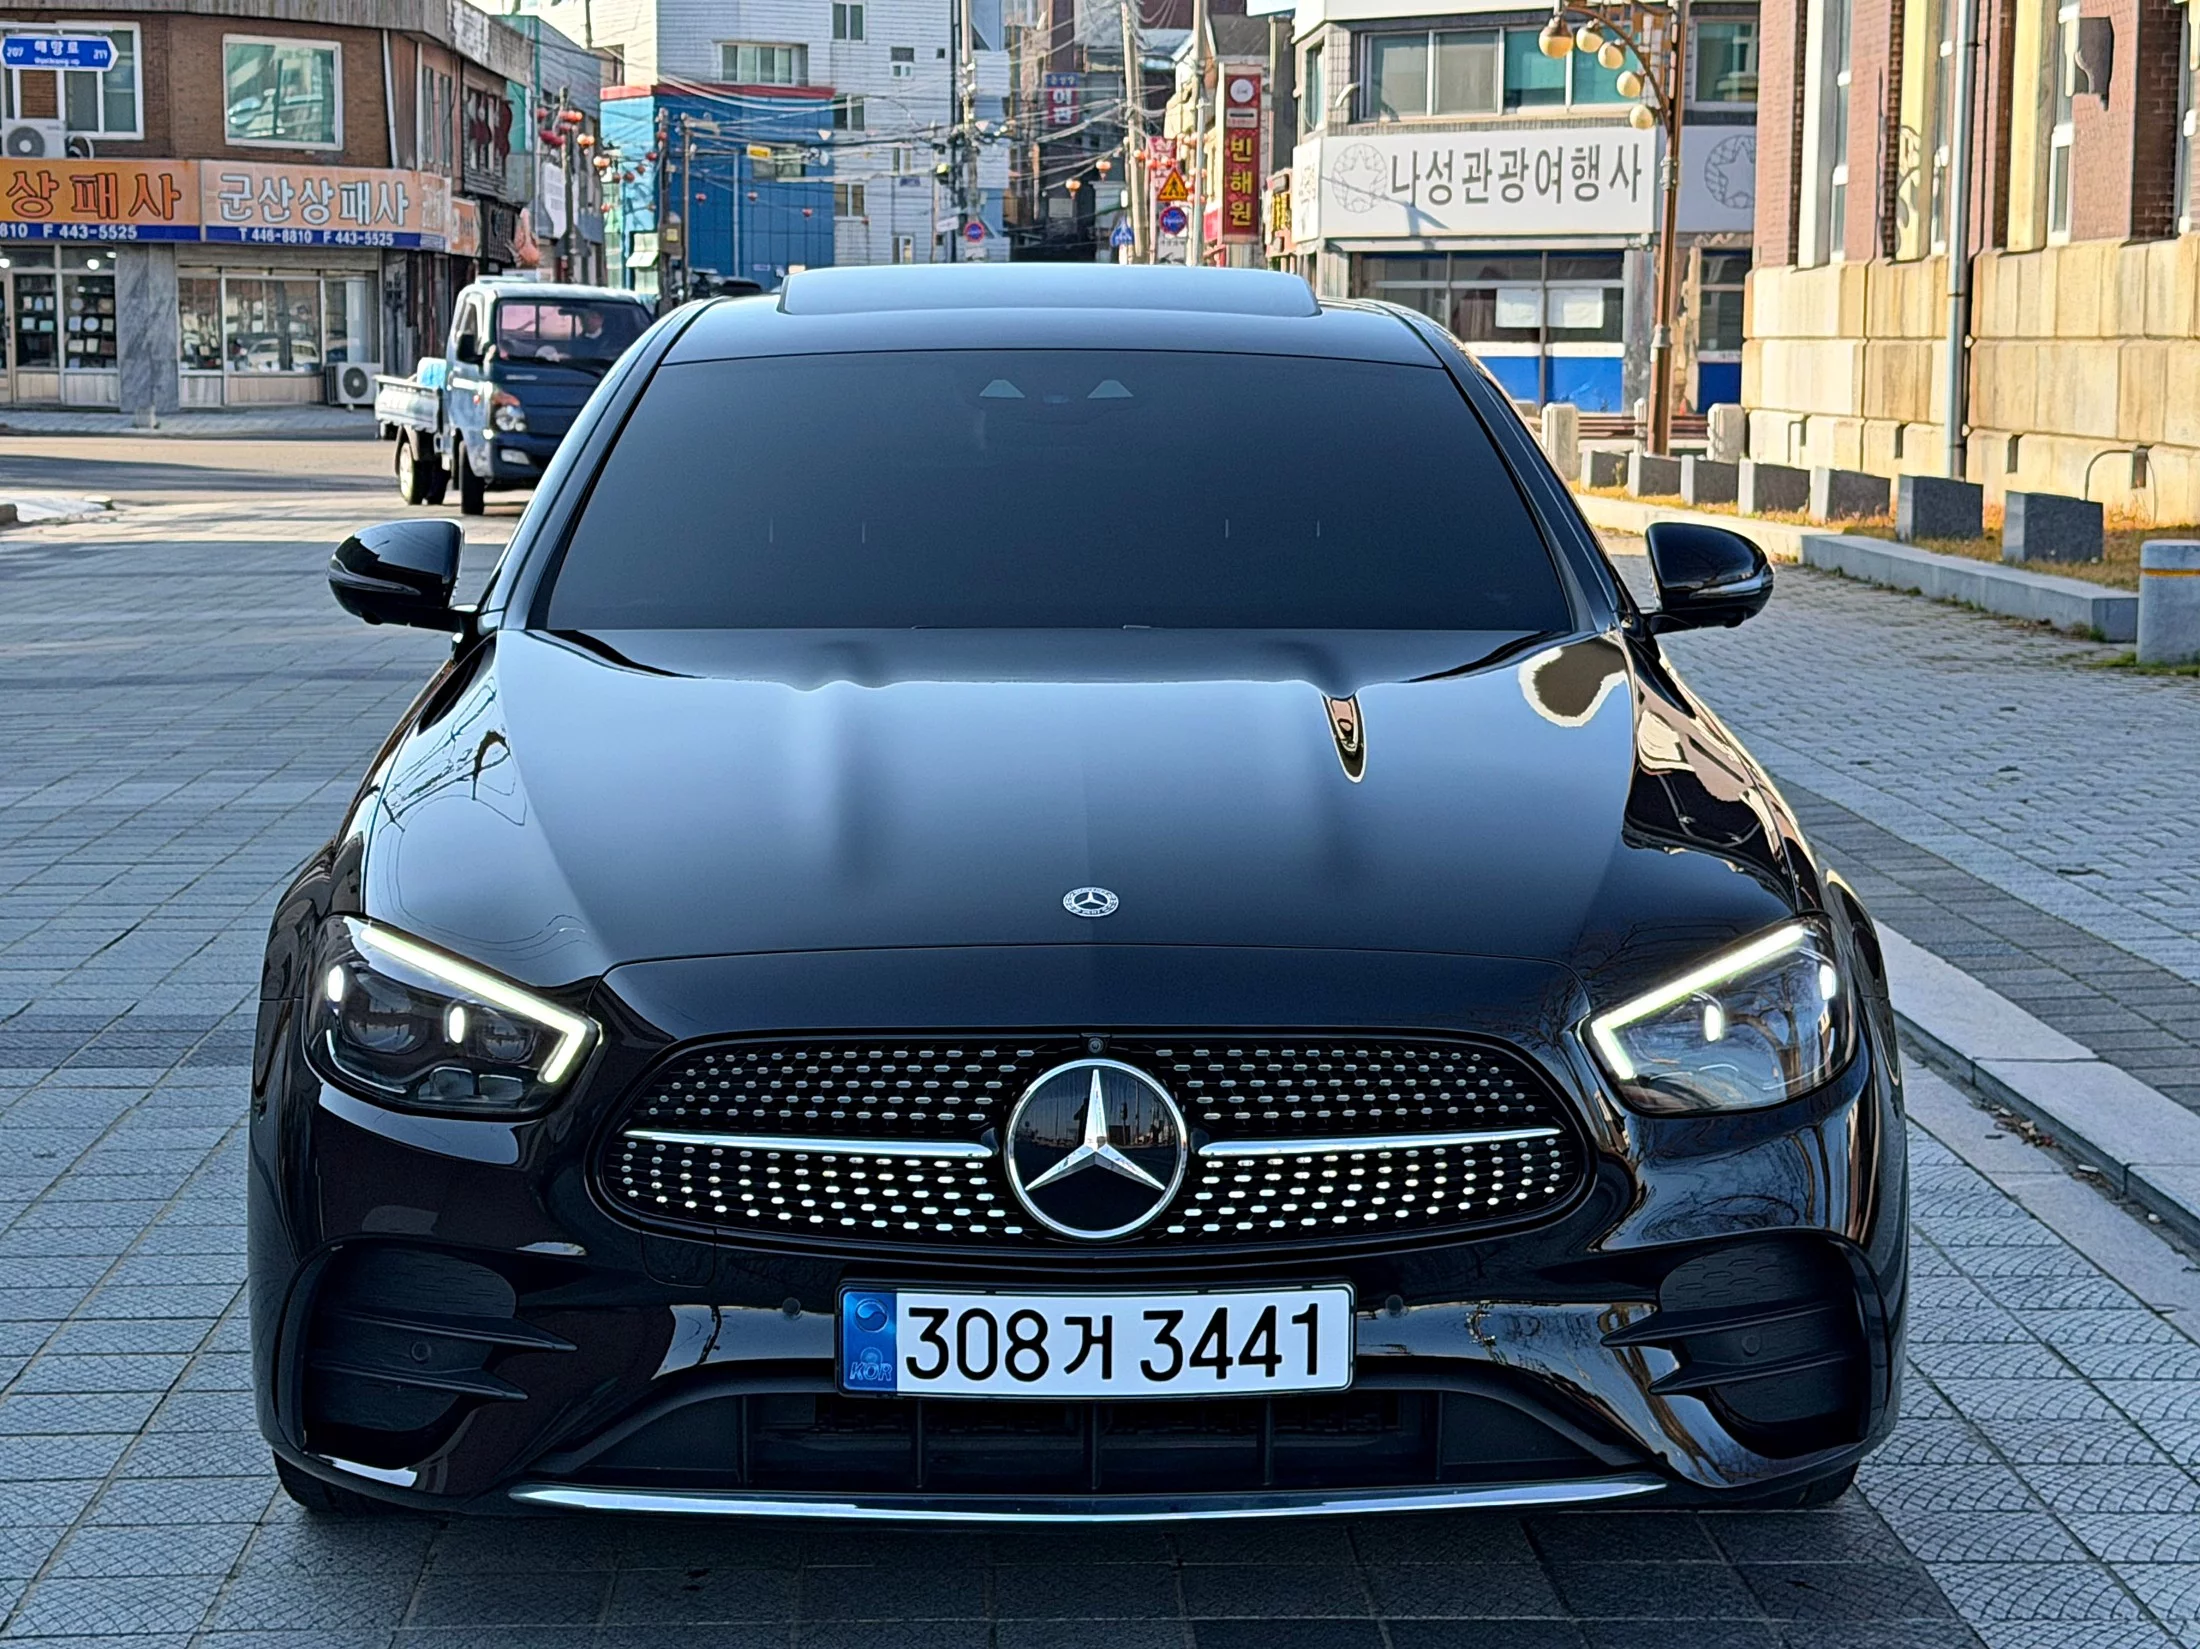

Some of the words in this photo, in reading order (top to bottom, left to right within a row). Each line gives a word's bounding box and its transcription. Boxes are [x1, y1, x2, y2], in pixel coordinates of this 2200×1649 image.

[6, 170, 182, 221] 상패사
[218, 172, 410, 226] 군산상패사
[1230, 137, 1253, 226] 빈해원
[1391, 143, 1642, 207] 나성관광여행사
[43, 224, 53, 237] F
[59, 225, 138, 240] 443-5525
[238, 227, 247, 241] T
[323, 231, 333, 244] F
[335, 231, 395, 246] 443-5525
[906, 1307, 1113, 1382] 308거
[1139, 1302, 1319, 1382] 3441
[849, 1361, 893, 1382] KOR
